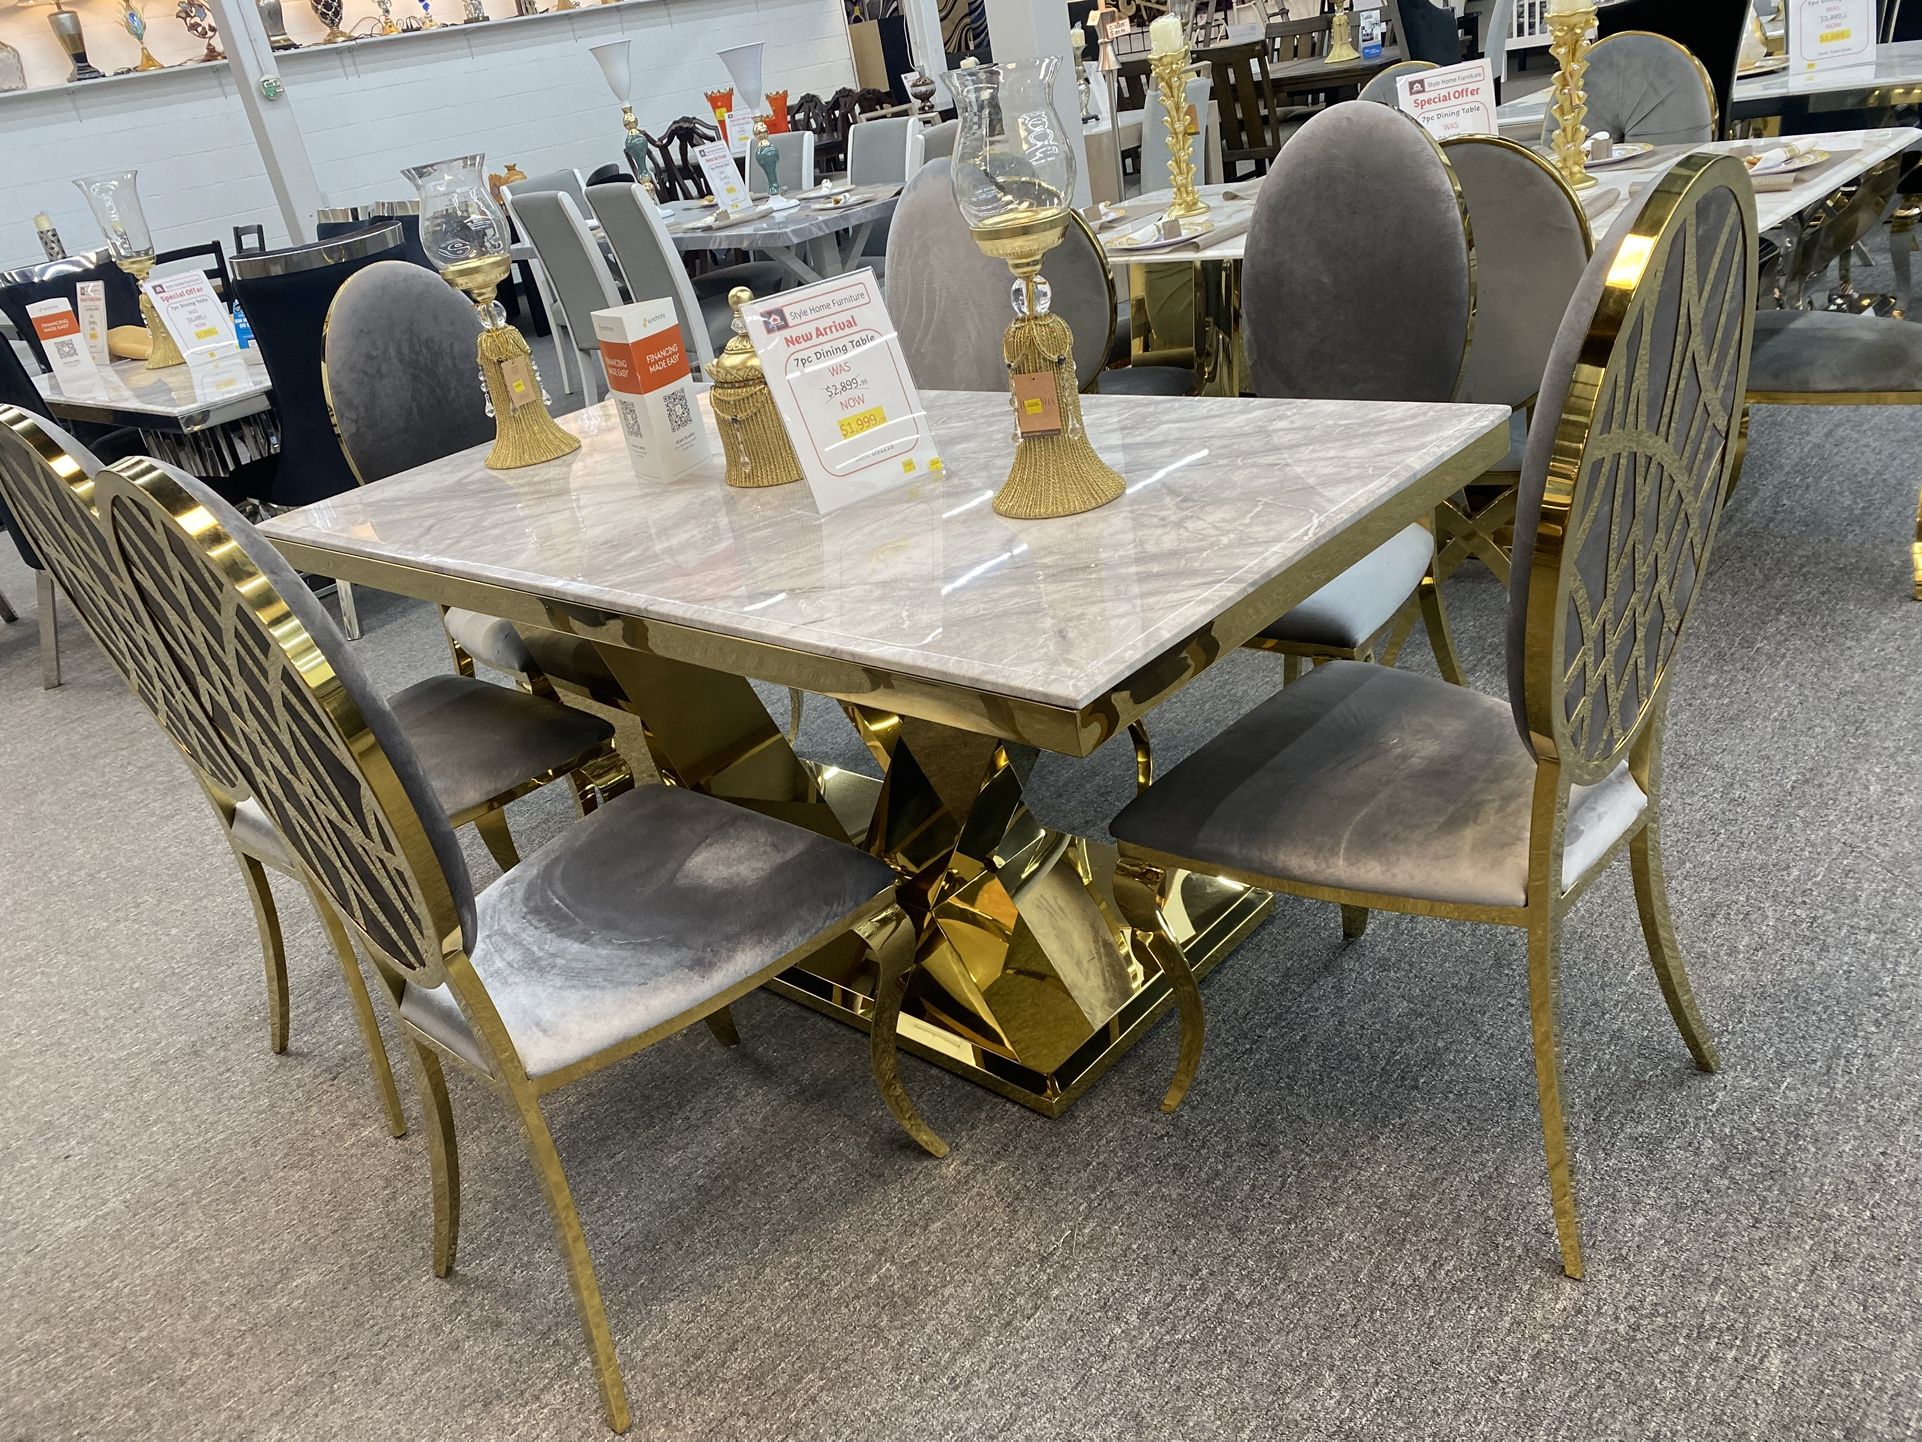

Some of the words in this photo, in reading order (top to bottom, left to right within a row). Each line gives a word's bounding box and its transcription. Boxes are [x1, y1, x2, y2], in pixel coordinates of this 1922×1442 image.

[1427, 79, 1441, 89] Style
[1441, 76, 1457, 86] Home
[1457, 72, 1481, 82] Furniture
[1413, 91, 1451, 110] Special
[1452, 87, 1481, 101] Offer
[1421, 113, 1435, 123] 7pc
[1436, 109, 1460, 120] Dining
[1461, 105, 1481, 115] Table
[1443, 122, 1459, 131] WAS
[160, 290, 186, 304] Special
[185, 286, 204, 297] Offer
[789, 308, 809, 321] Style
[809, 302, 832, 315] Home
[831, 291, 865, 307] Furniture
[783, 331, 813, 348] New
[815, 315, 858, 339] Arrival
[646, 344, 679, 364] FINANCING
[793, 355, 813, 368] 7pc
[814, 343, 848, 361] Dining
[848, 333, 875, 349] Table
[648, 360, 667, 374] MADE
[666, 353, 680, 366] EASY
[827, 361, 852, 377] WAS
[839, 393, 866, 411] NOW
